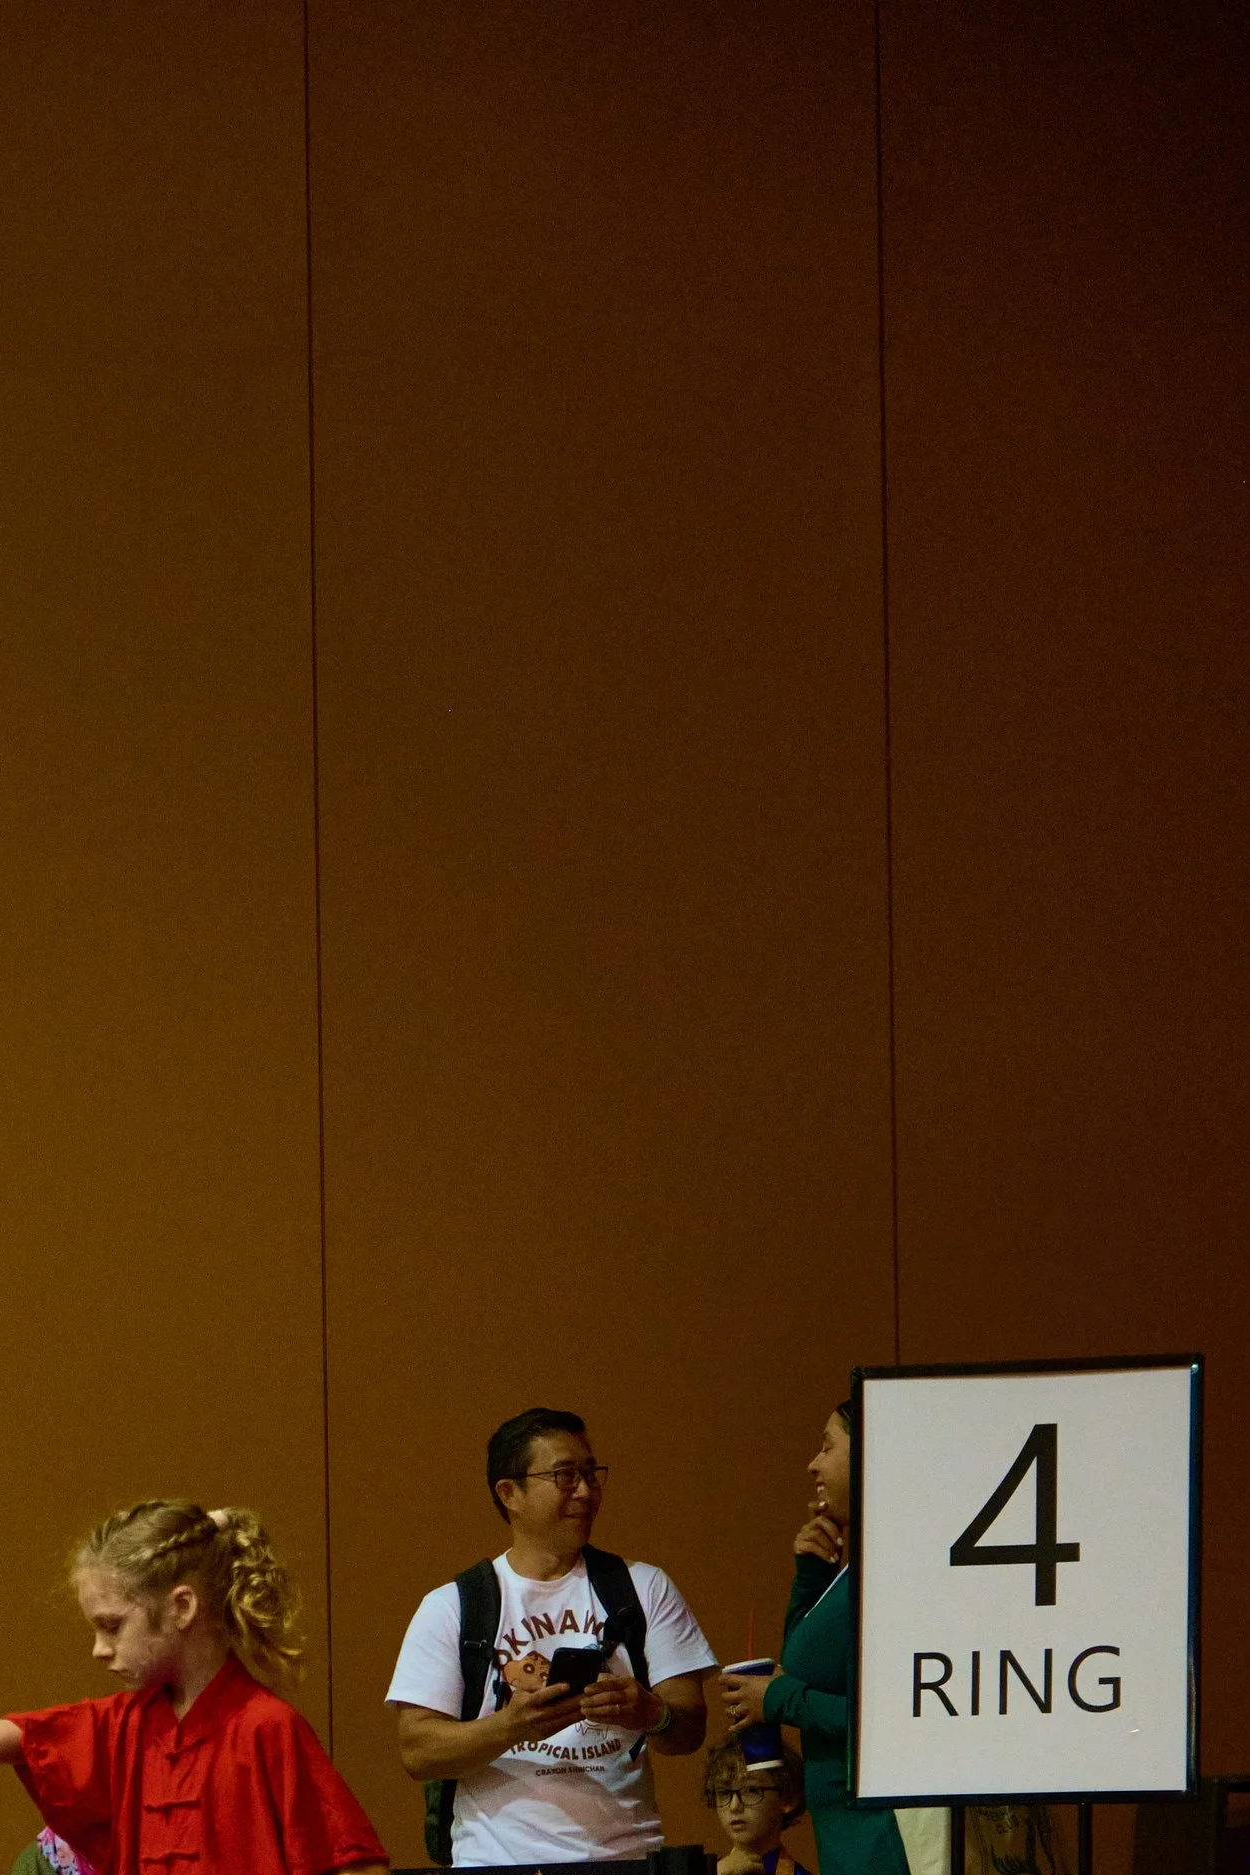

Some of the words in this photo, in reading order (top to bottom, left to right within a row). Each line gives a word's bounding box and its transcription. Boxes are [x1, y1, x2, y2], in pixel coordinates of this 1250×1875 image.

[950, 1423, 1080, 1606] 4
[494, 1608, 608, 1669] OKINAW
[912, 1645, 1122, 1718] RING
[535, 1767, 567, 1777] CRAYON
[582, 1738, 622, 1761] ISLAND
